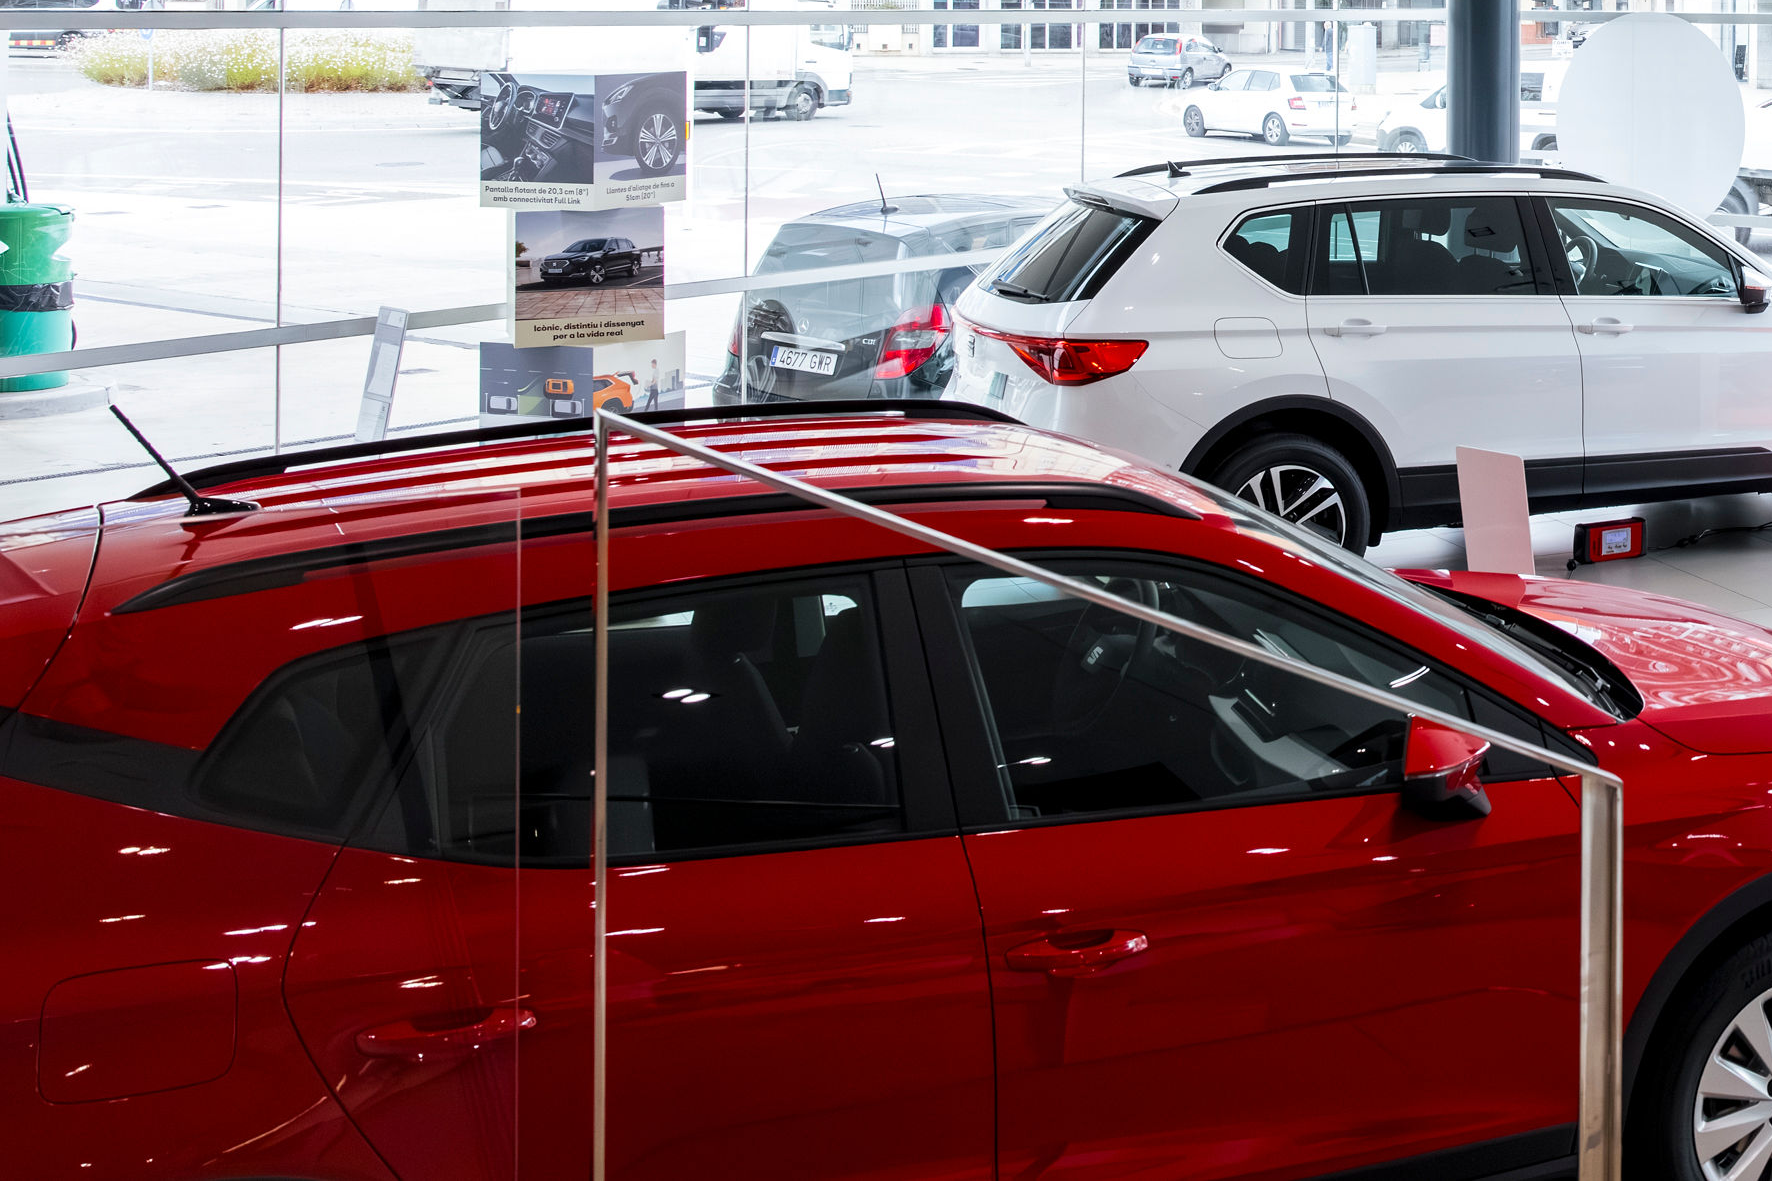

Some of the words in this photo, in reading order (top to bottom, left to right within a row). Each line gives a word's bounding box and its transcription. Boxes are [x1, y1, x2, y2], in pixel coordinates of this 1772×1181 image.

[484, 185, 514, 194] Pantalla
[514, 185, 537, 195] flotant
[538, 186, 547, 195] de
[547, 186, 564, 196] 20,3
[564, 188, 575, 196] cm
[606, 186, 627, 195] Llantes
[627, 184, 652, 194] d'aliatge
[652, 182, 660, 190] de
[493, 194, 508, 202] amb
[508, 195, 553, 204] connectivitat
[554, 196, 567, 205] Full
[567, 196, 581, 205] Link
[533, 324, 562, 332] Icònic,
[563, 322, 599, 331] distintiu
[599, 321, 603, 329] i
[603, 319, 645, 329] dissenyat
[552, 333, 568, 341] per
[576, 331, 586, 339] la
[586, 330, 605, 338] vida
[605, 329, 624, 337] real
[779, 349, 807, 368] 4677
[809, 355, 832, 372] GWR
